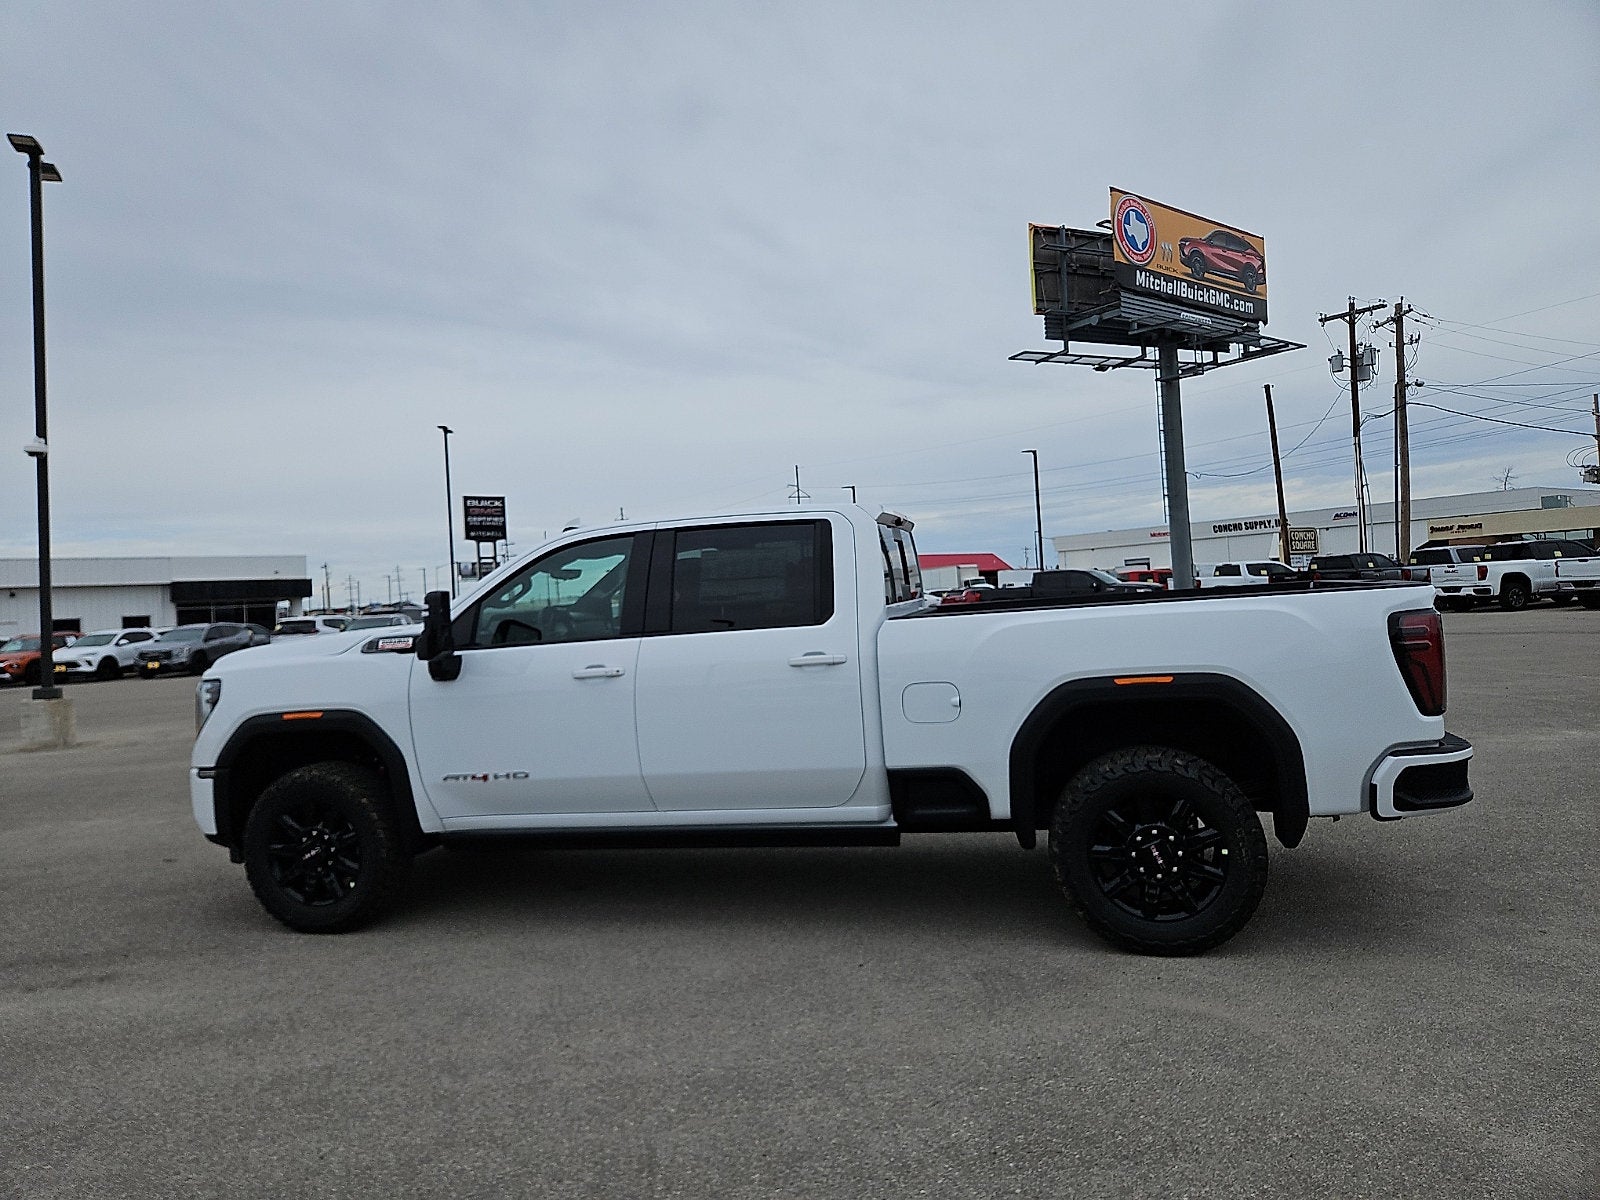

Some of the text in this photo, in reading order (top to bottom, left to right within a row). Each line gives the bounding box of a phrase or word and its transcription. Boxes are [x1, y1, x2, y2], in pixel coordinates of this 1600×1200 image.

[1156, 263, 1179, 274] BUICK
[1135, 269, 1254, 314] MitchellBuickGMC.com
[466, 499, 503, 507] BUICK
[1212, 522, 1243, 534] CONCHO
[1290, 531, 1315, 540] CONCHO
[1291, 540, 1316, 550] SQUARE
